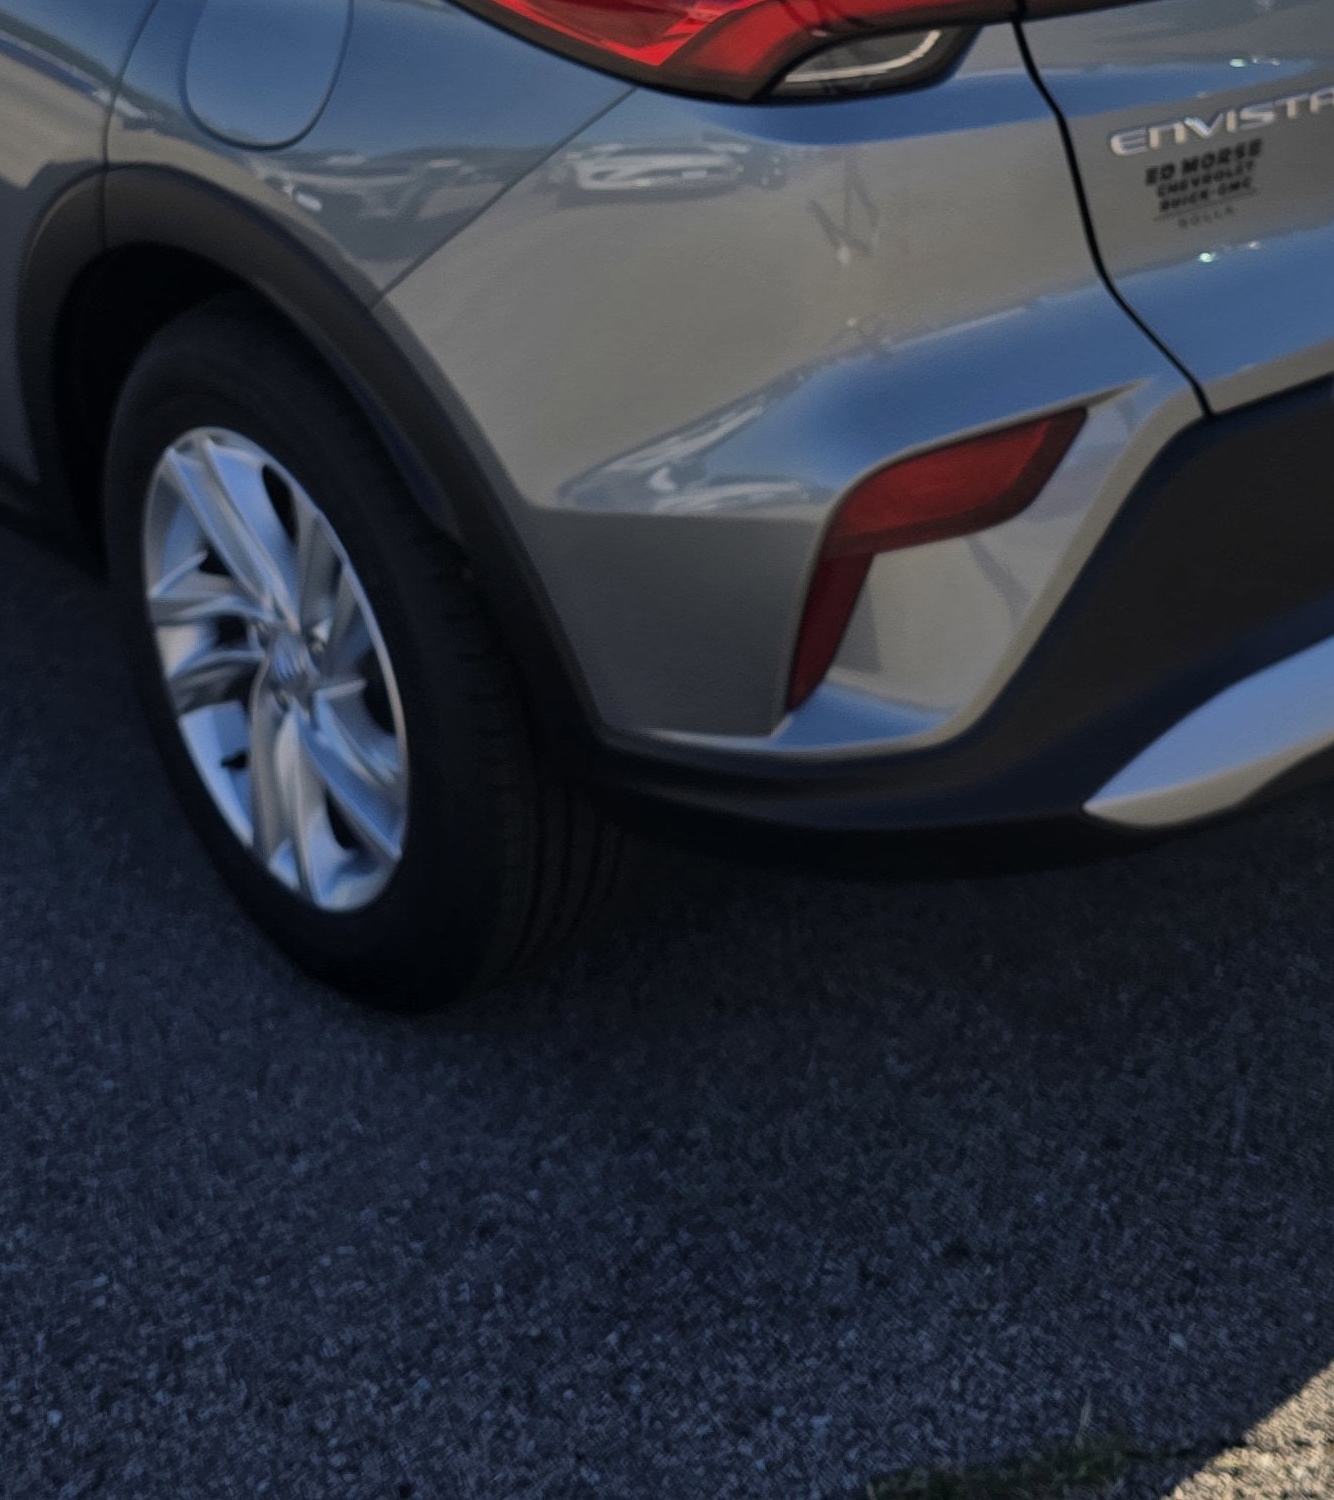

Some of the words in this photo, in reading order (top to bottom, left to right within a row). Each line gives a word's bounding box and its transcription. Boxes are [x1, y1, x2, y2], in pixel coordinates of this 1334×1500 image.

[1145, 162, 1175, 186] ED
[1181, 138, 1262, 173] MORSE
[1157, 159, 1255, 198] CHEVROLET
